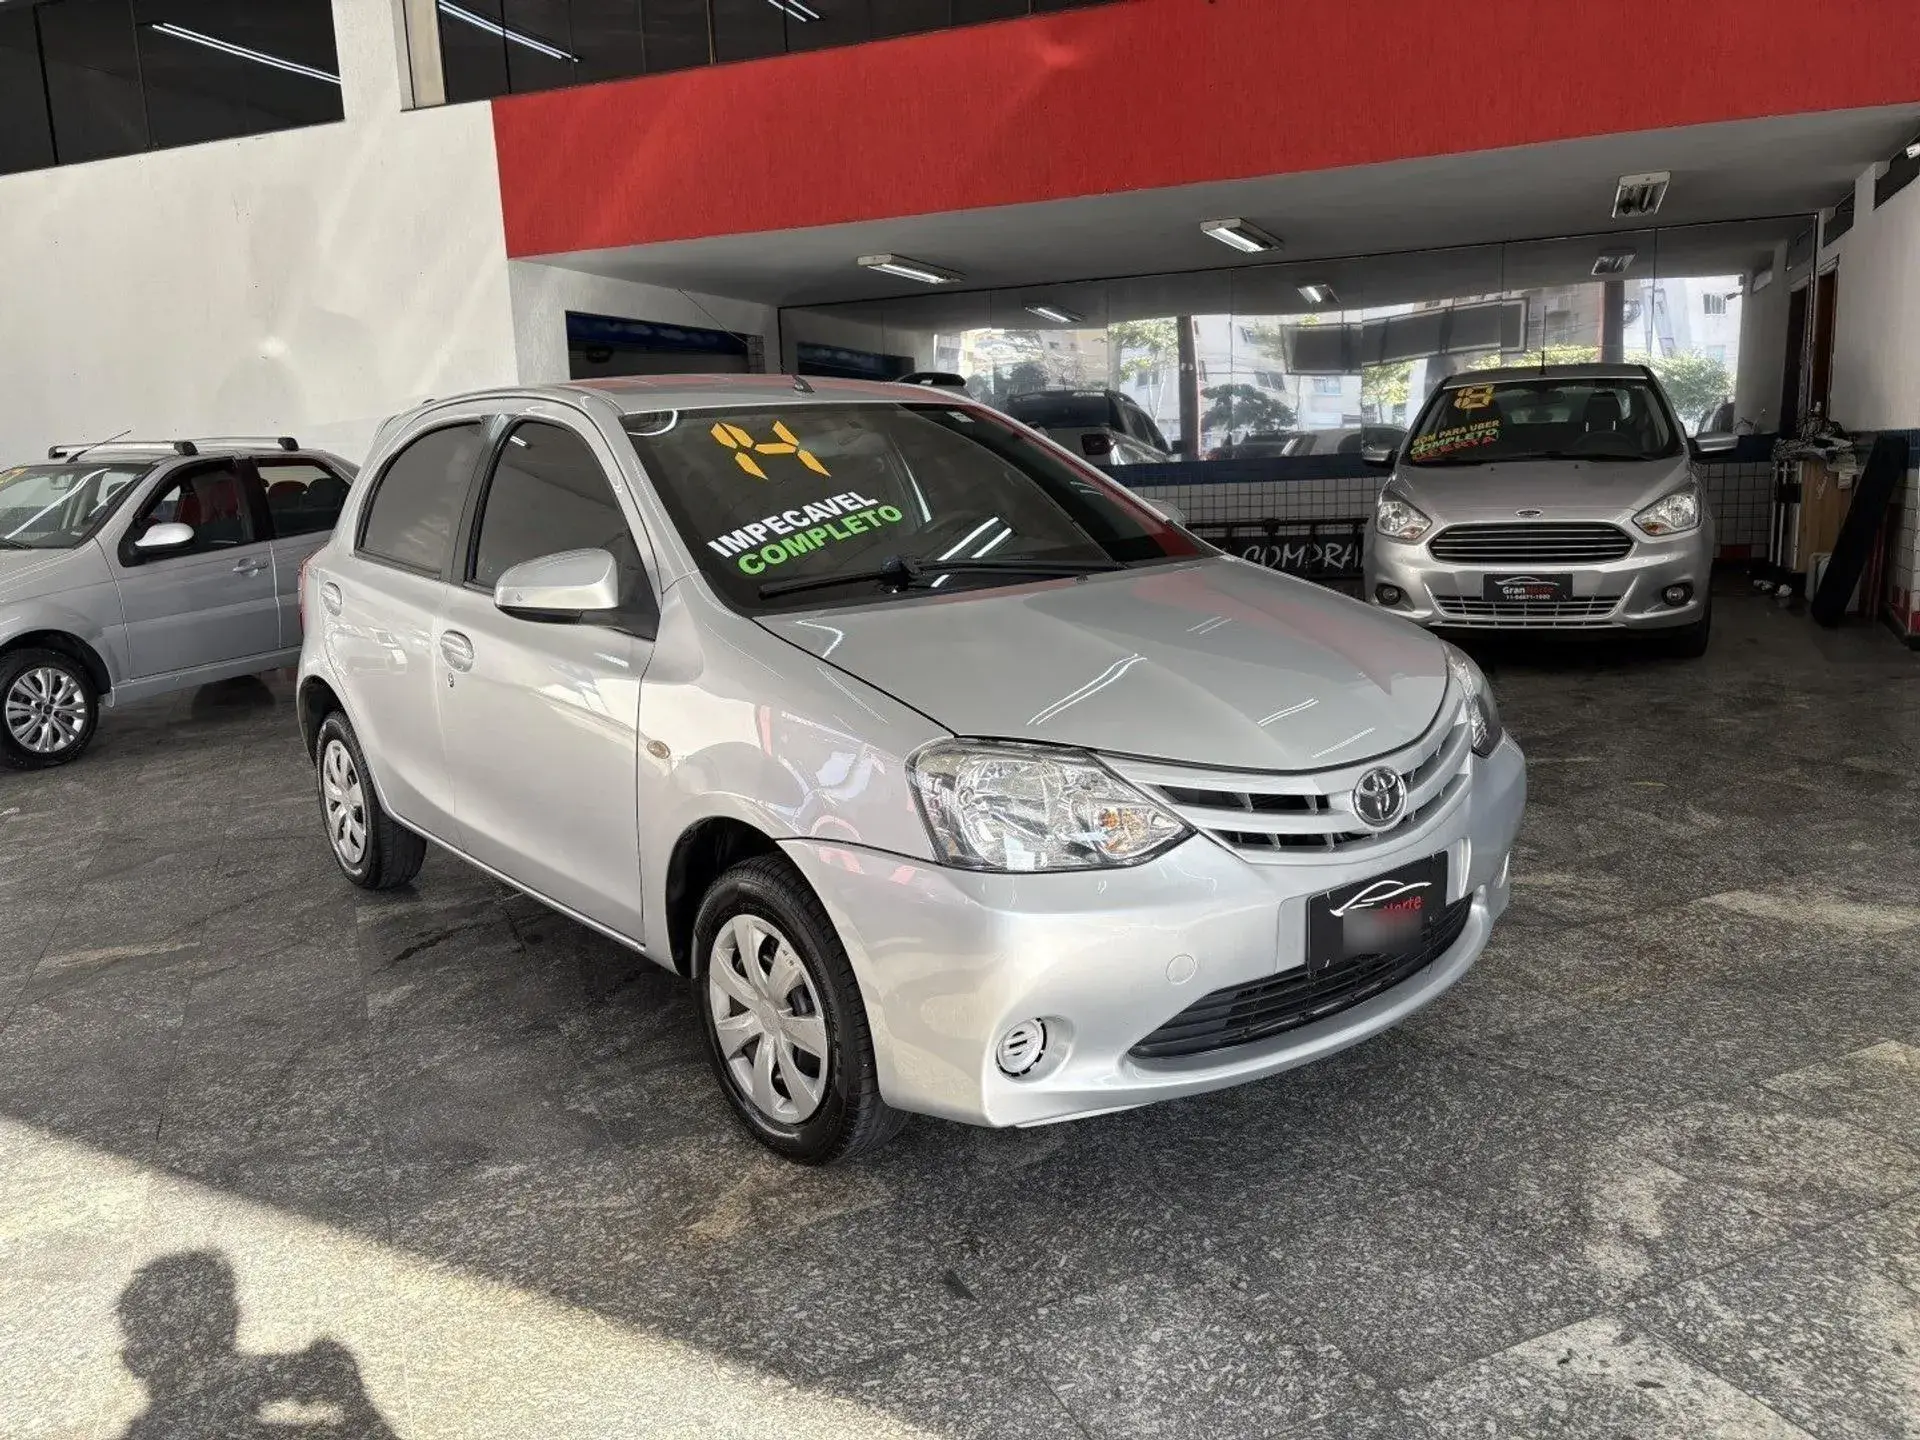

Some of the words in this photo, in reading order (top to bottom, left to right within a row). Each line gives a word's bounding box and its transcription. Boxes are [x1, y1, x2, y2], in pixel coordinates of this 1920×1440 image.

[710, 420, 832, 481] 14
[1470, 420, 1500, 431] UBER
[707, 491, 880, 558] IMPECAVEL
[738, 505, 903, 576] COMPLETO
[1242, 542, 1364, 569] COMPRA
